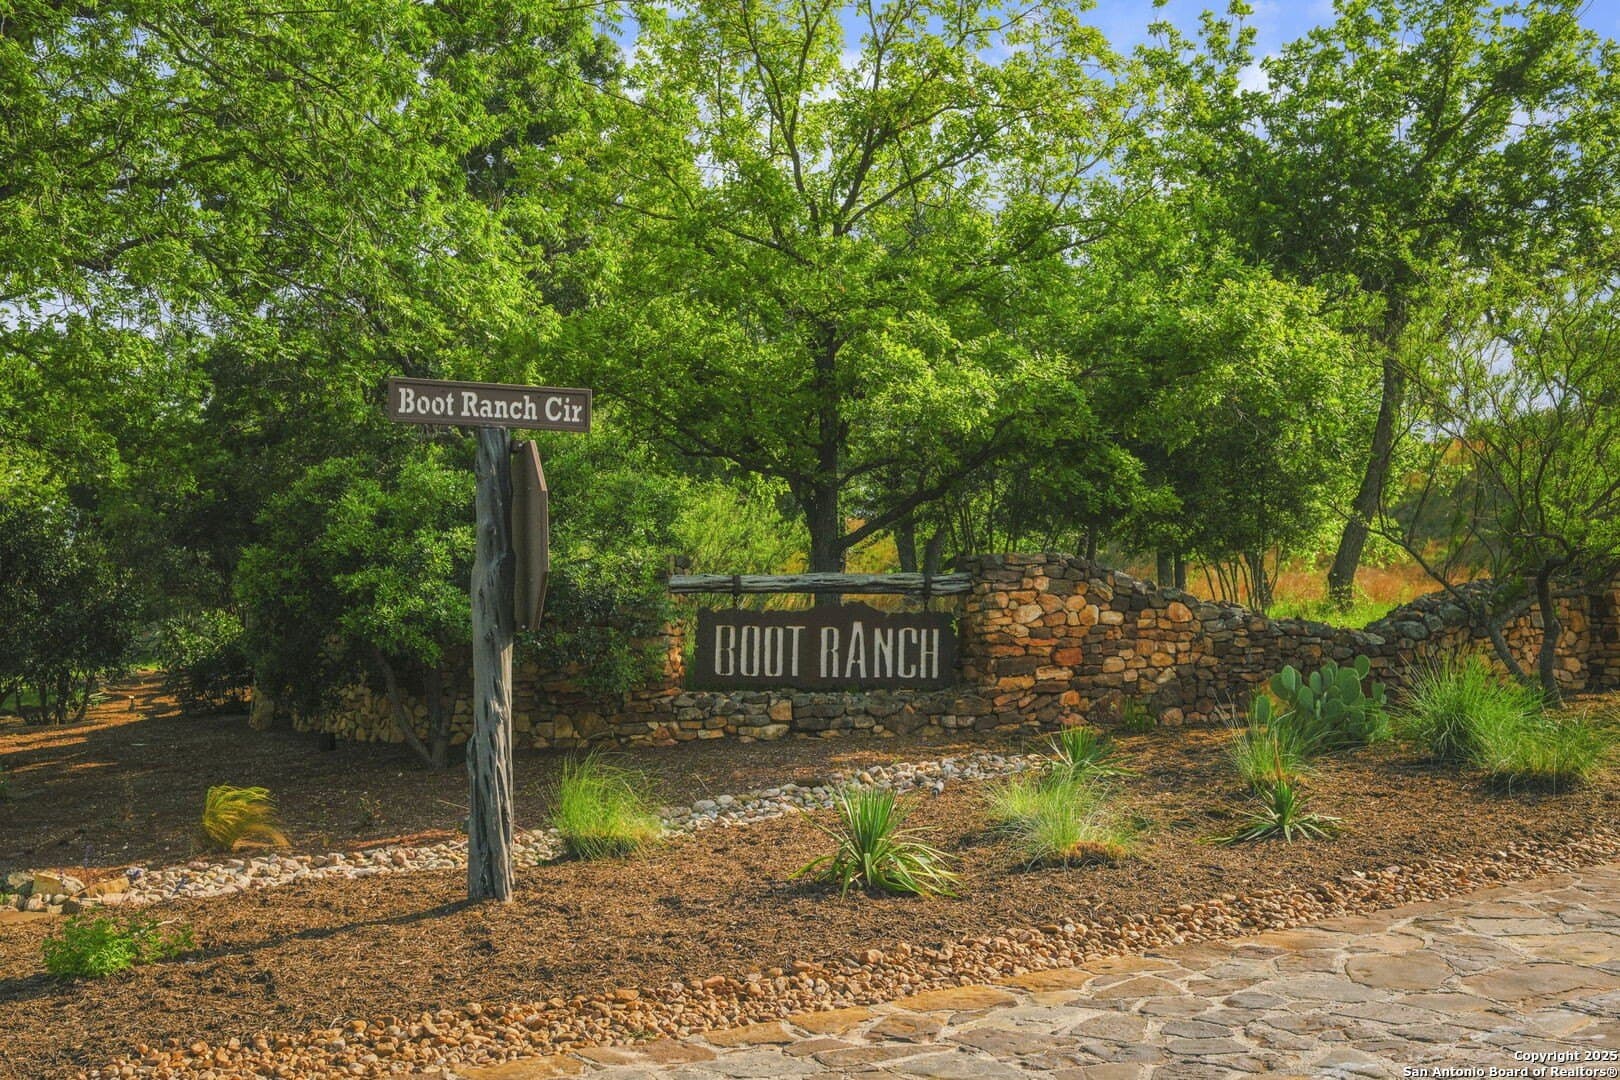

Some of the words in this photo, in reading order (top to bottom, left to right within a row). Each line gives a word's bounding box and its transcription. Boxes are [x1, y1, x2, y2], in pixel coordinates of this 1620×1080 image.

[398, 387, 454, 416] Boot
[460, 391, 538, 420] Ranch
[714, 624, 806, 677] BOOT
[819, 621, 940, 679] RANCH
